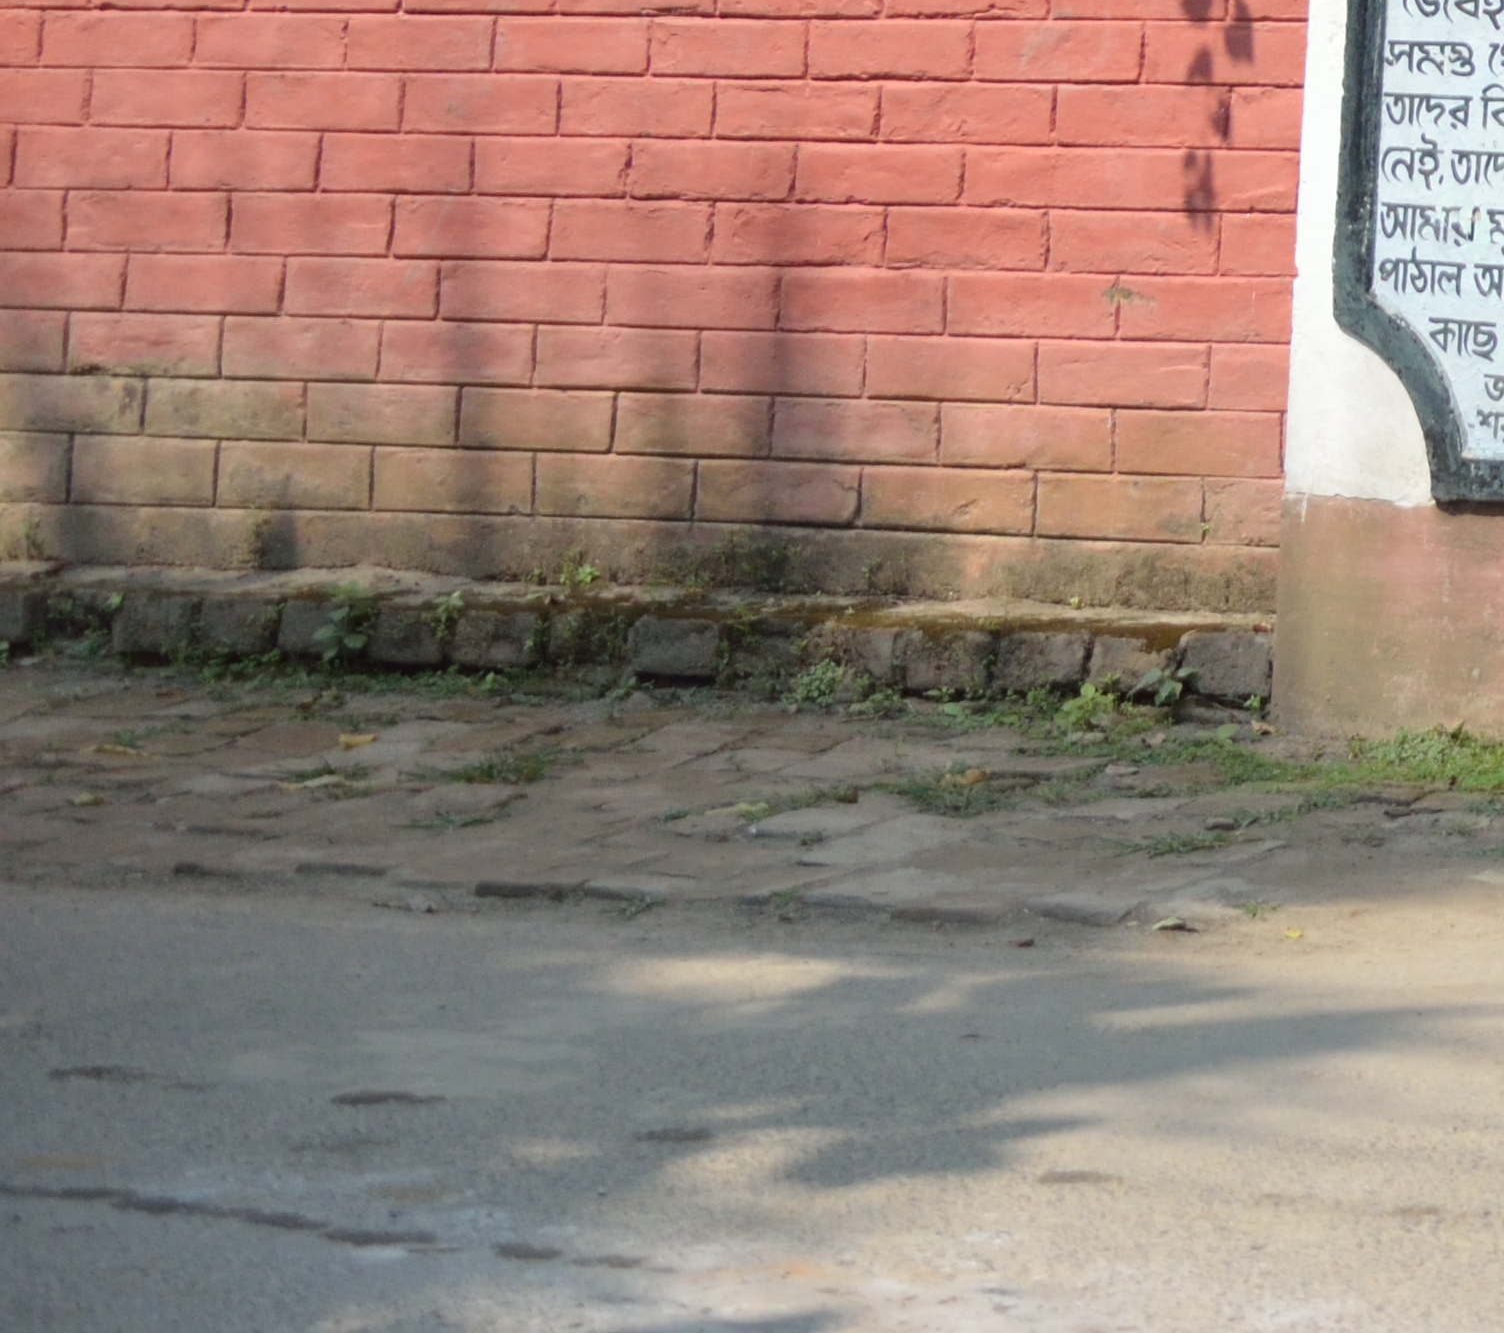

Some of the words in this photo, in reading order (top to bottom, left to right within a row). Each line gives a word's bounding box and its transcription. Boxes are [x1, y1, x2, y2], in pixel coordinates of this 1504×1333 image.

[1383, 91, 1474, 130] তাদের
[1378, 245, 1467, 298] পাঠাল
[1428, 316, 1498, 363] কাছে
